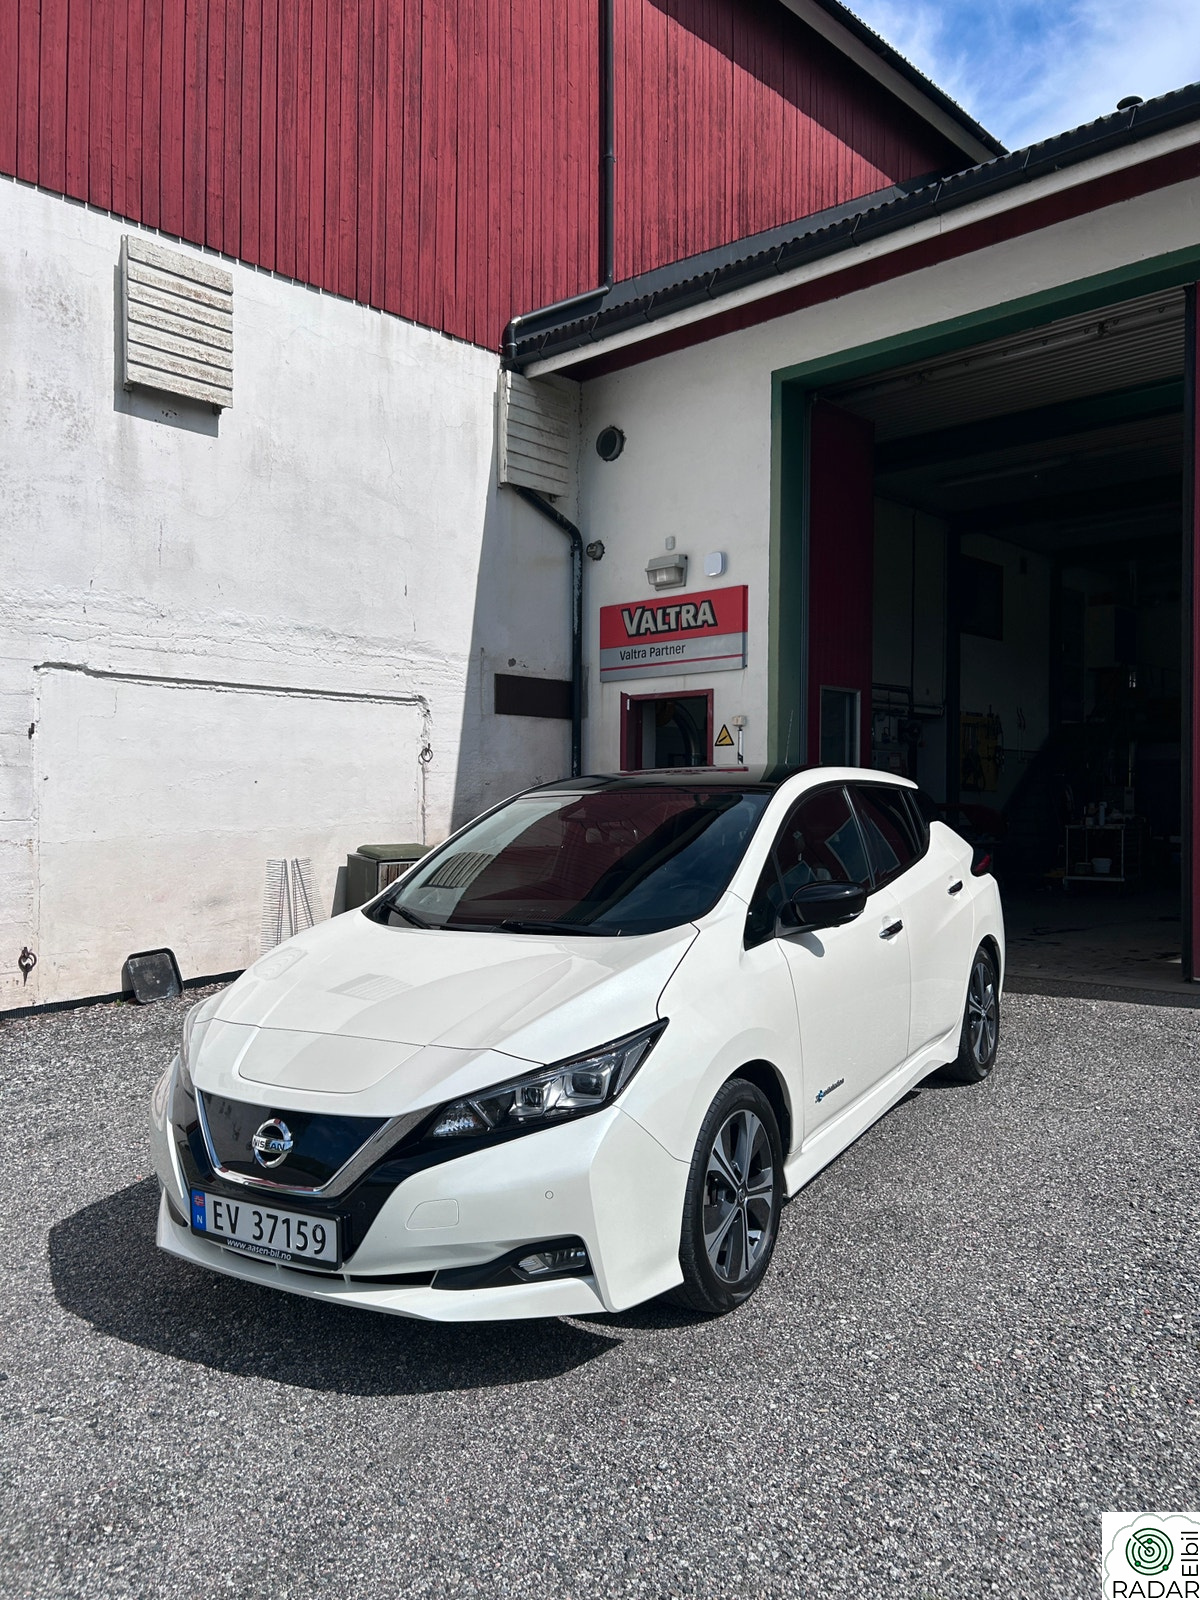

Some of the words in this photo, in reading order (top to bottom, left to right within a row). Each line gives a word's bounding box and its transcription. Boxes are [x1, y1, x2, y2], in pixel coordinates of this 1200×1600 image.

[621, 600, 718, 637] VALTRA
[619, 649, 647, 661] Valtra
[650, 644, 686, 657] Partner
[196, 1215, 203, 1225] N
[213, 1200, 240, 1234] EV
[252, 1210, 326, 1254] 37159
[226, 1238, 291, 1261] www.aasen-bil.no
